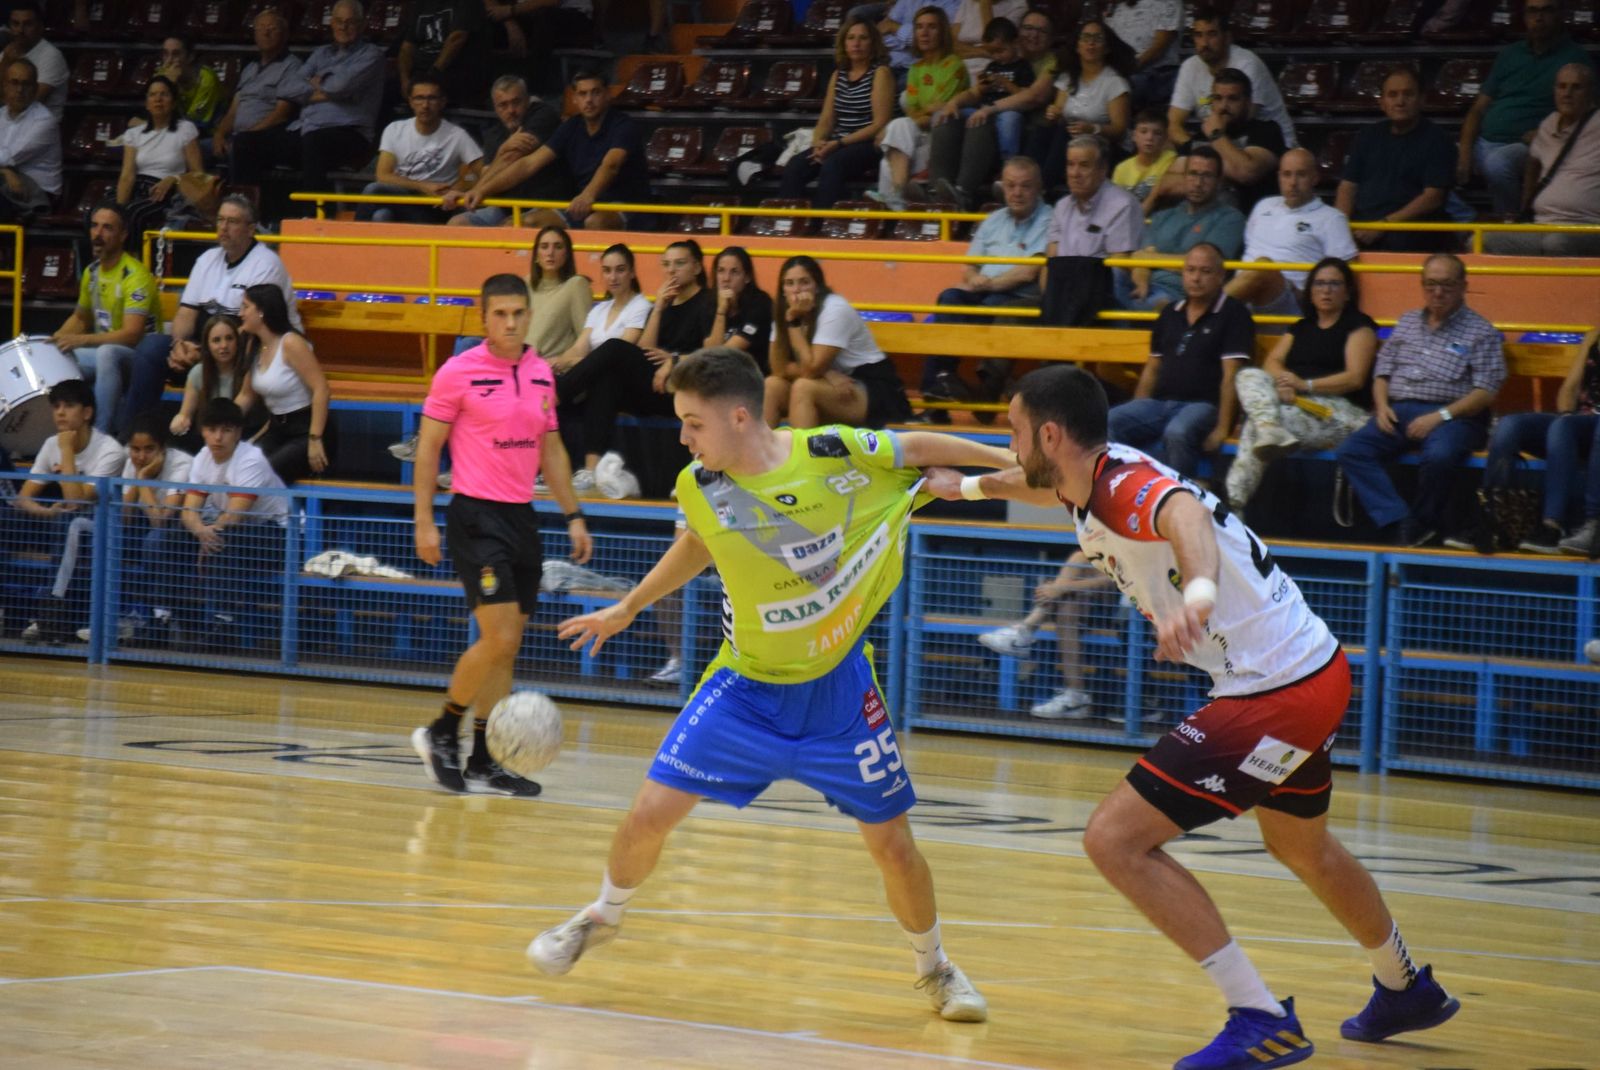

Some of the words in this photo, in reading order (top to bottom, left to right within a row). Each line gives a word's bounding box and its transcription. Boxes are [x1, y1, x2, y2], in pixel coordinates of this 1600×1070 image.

[827, 469, 870, 496] 25
[773, 564, 830, 591] CASTILLA
[764, 600, 825, 624] CAJA
[854, 726, 902, 784] 25
